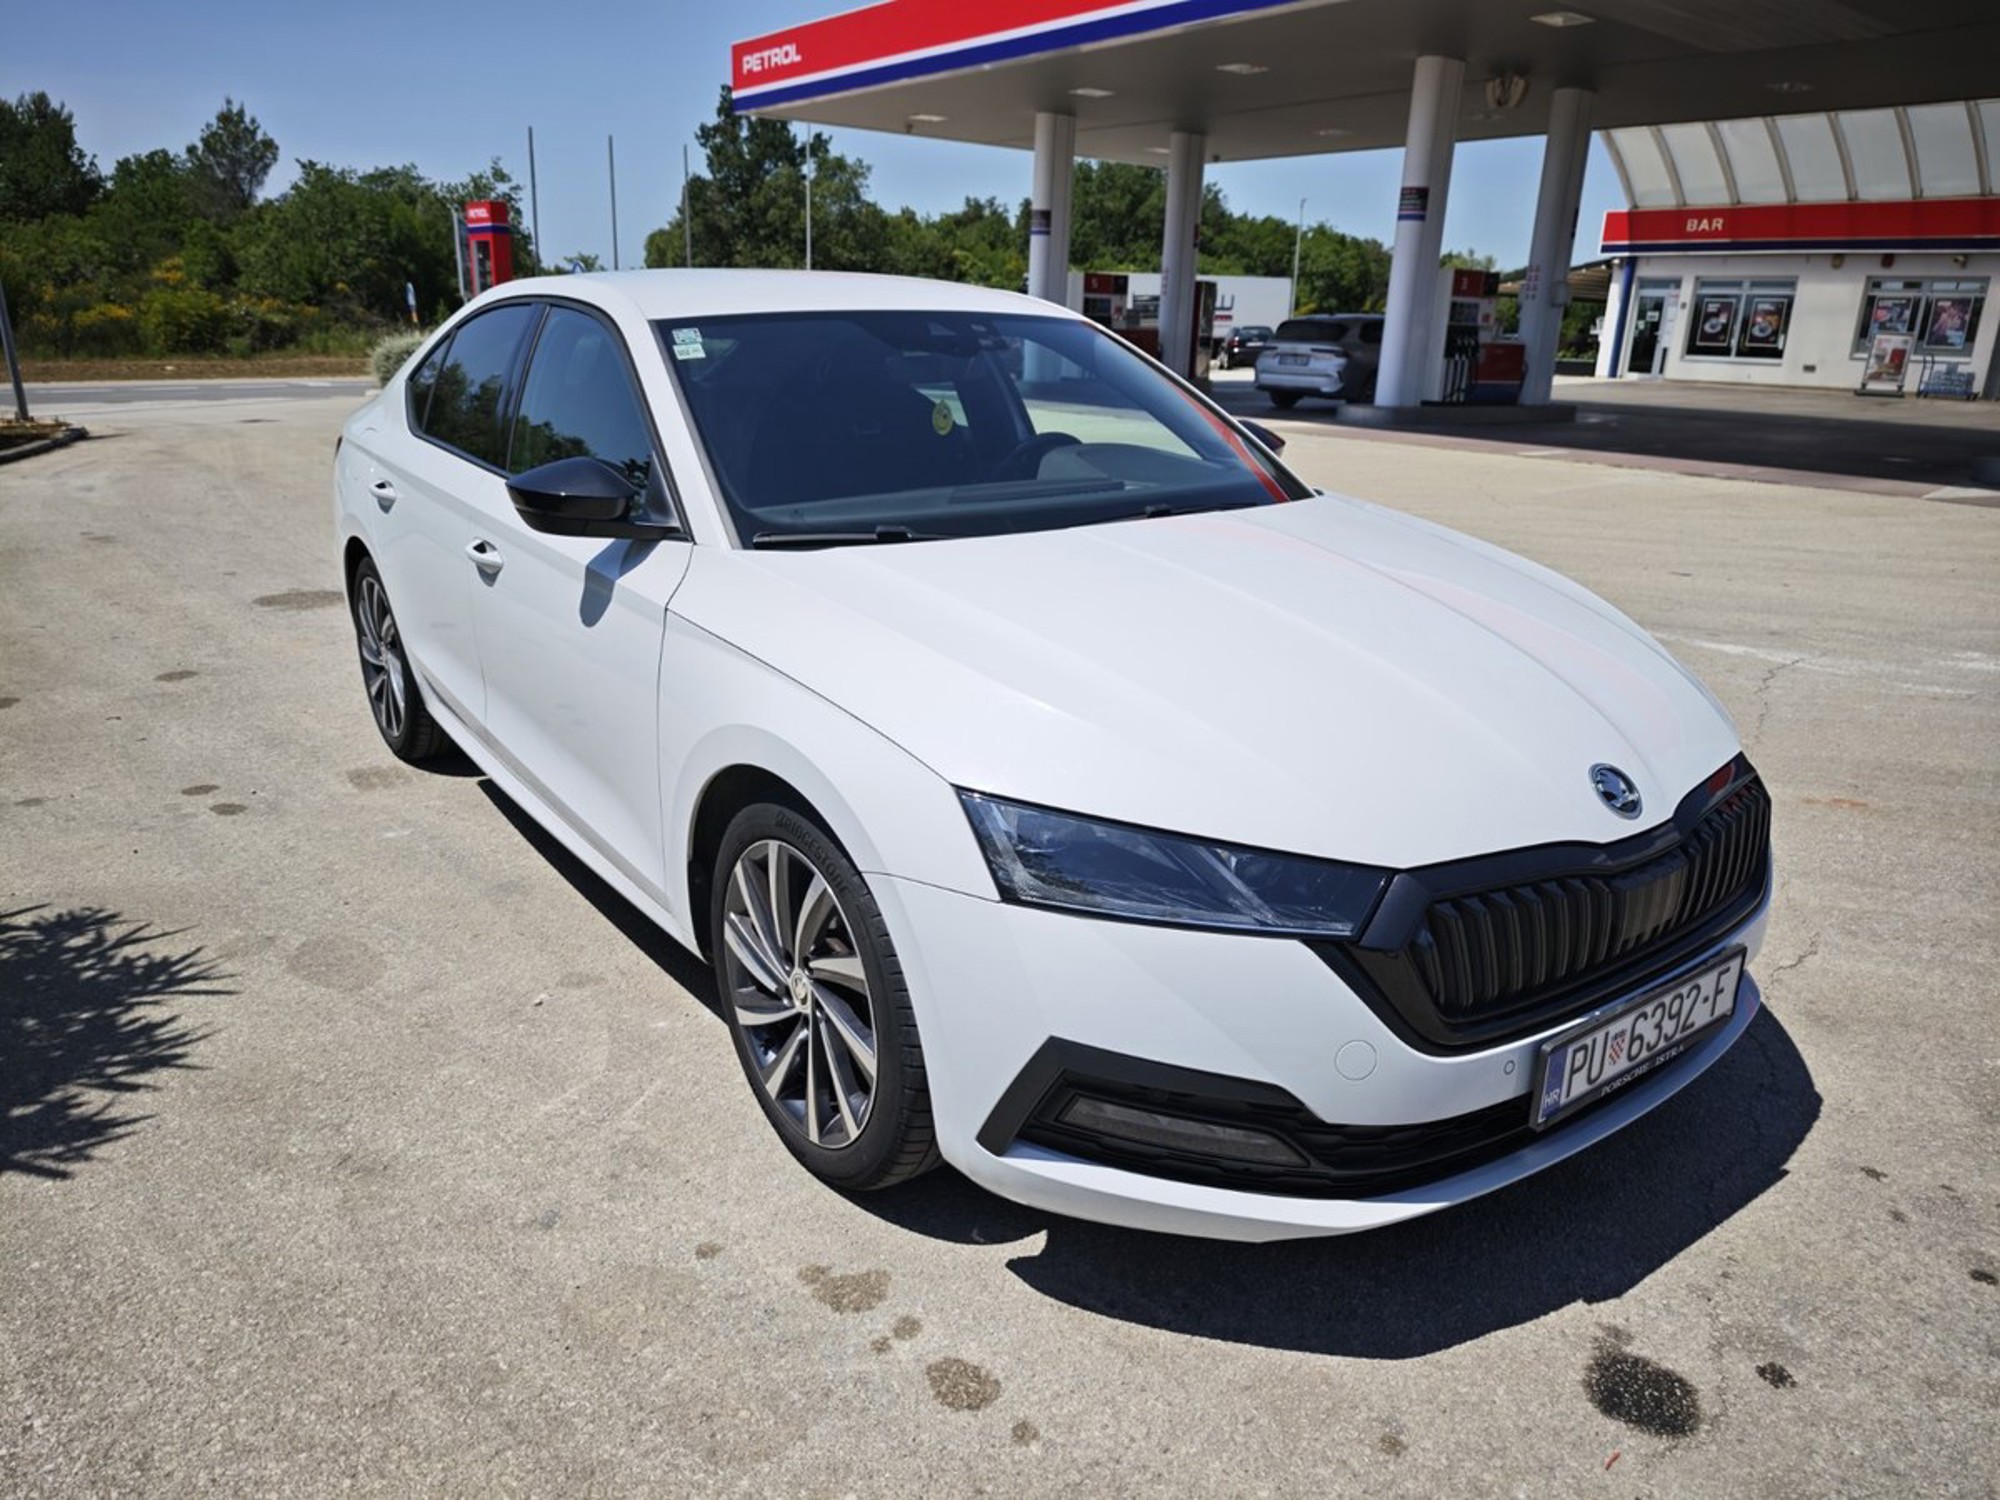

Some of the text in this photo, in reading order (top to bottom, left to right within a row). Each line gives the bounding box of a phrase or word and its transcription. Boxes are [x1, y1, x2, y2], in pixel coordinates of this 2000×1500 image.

[743, 43, 802, 74] PETROL
[1686, 217, 1724, 232] BAR
[1566, 966, 1731, 1098] PU 6392-F
[1600, 1063, 1650, 1097] PORSCHE
[1544, 1088, 1560, 1107] HR
